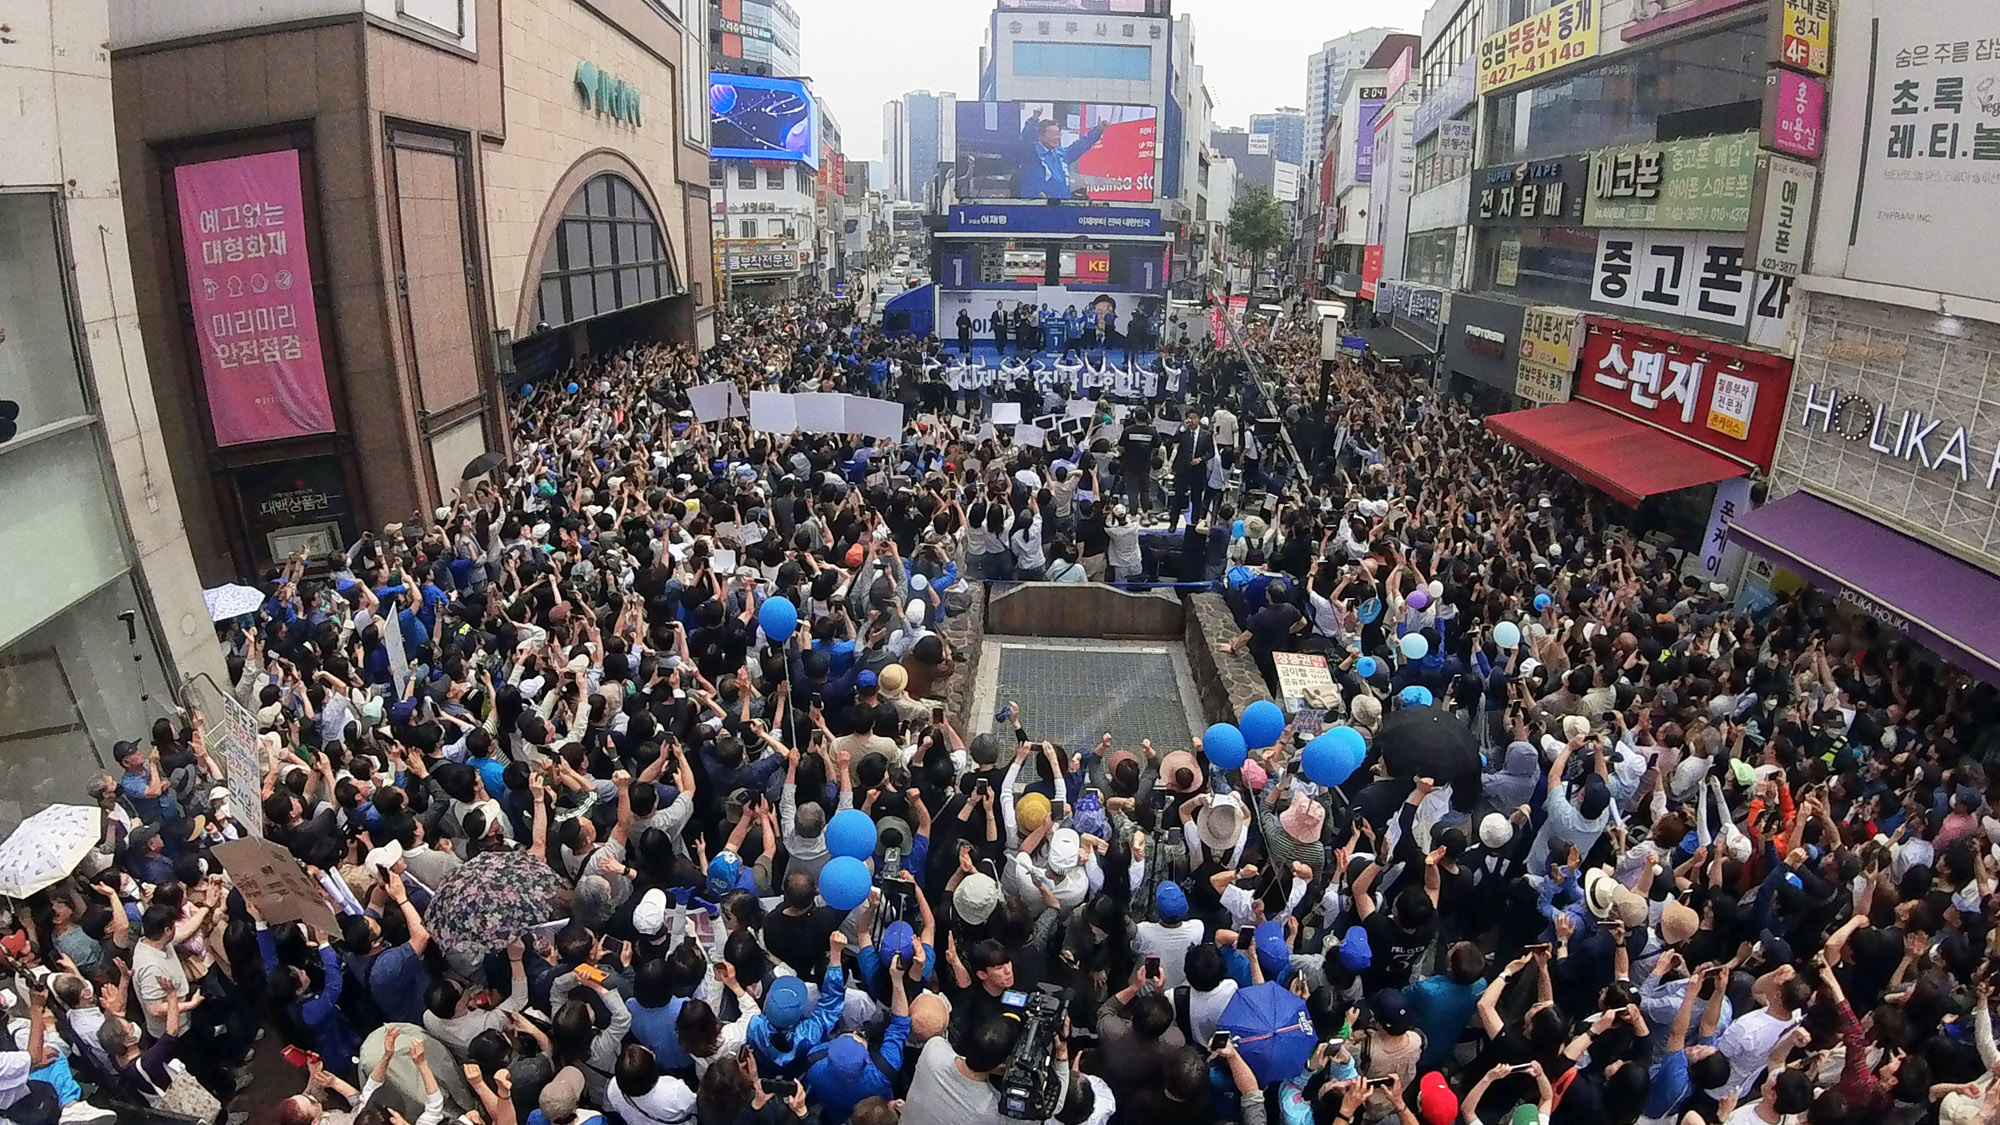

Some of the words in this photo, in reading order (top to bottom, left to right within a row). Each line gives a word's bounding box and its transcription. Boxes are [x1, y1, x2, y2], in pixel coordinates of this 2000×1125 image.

[1482, 14, 1552, 71] 영남부동산
[1558, 0, 1591, 41] 중개
[1794, 14, 1820, 40] 성지
[1488, 42, 1571, 86] 427-4114
[1786, 39, 1808, 64] 4F
[1895, 44, 1930, 69] 숨은
[1934, 41, 1970, 65] 주름
[1766, 76, 1776, 85] F3
[1795, 81, 1808, 115] 홍
[1782, 117, 1816, 150] 미용실
[1530, 164, 1558, 178] VAPE
[1594, 152, 1663, 199] 에코폰
[1757, 159, 1766, 170] F2
[1480, 182, 1565, 218] 전자담배
[1669, 177, 1699, 199] 아이폰
[1701, 174, 1748, 199] 스마트폰
[200, 203, 285, 234] 예고없는
[959, 212, 965, 224] 1
[1775, 180, 1798, 254] 에코폰
[202, 232, 287, 266] 대형화재
[953, 259, 962, 287] 1
[1089, 260, 1109, 271] KE
[1143, 262, 1152, 289] 1
[1600, 240, 1745, 317] 중고폰
[1761, 258, 1798, 274] 423-3877
[212, 305, 298, 338] 미리미리
[1524, 312, 1572, 346] 휴대폰성지
[216, 336, 301, 369] 안전점검
[1519, 364, 1548, 386] 영남부동산
[1718, 378, 1749, 399] 필름부착
[1718, 395, 1743, 414] 전문점
[1802, 383, 1969, 481] HOLIKA
[261, 493, 329, 515] 대백상품권
[1707, 500, 1735, 577] 폰케이
[1838, 588, 1873, 616] HOLIKA
[1873, 606, 1909, 633] HOLIKA
